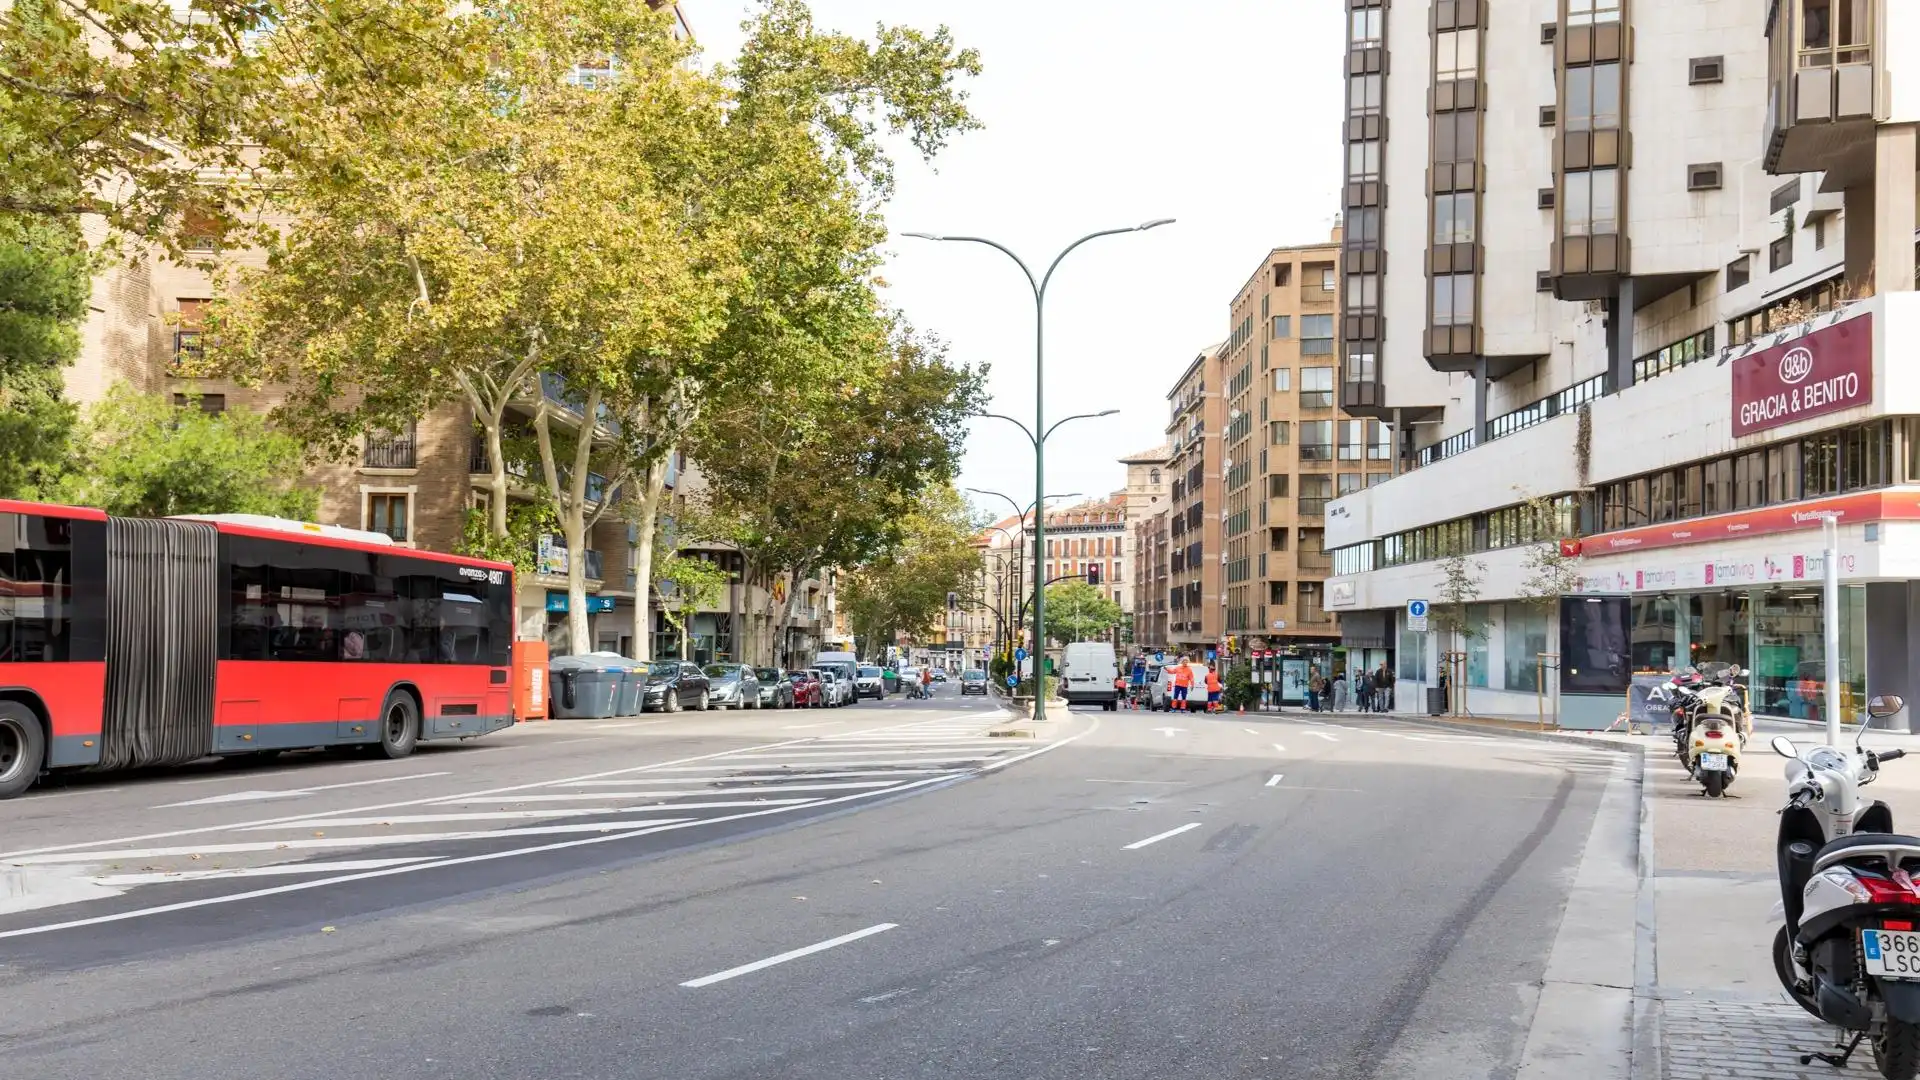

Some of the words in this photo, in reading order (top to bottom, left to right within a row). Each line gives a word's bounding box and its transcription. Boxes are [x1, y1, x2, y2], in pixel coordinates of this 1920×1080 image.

[1784, 352, 1808, 379] g&b
[1740, 393, 1788, 426] GRACIA
[1791, 389, 1801, 413] &
[1804, 372, 1858, 409] BENITO
[489, 570, 503, 585] 4907
[1880, 934, 1920, 954] 366
